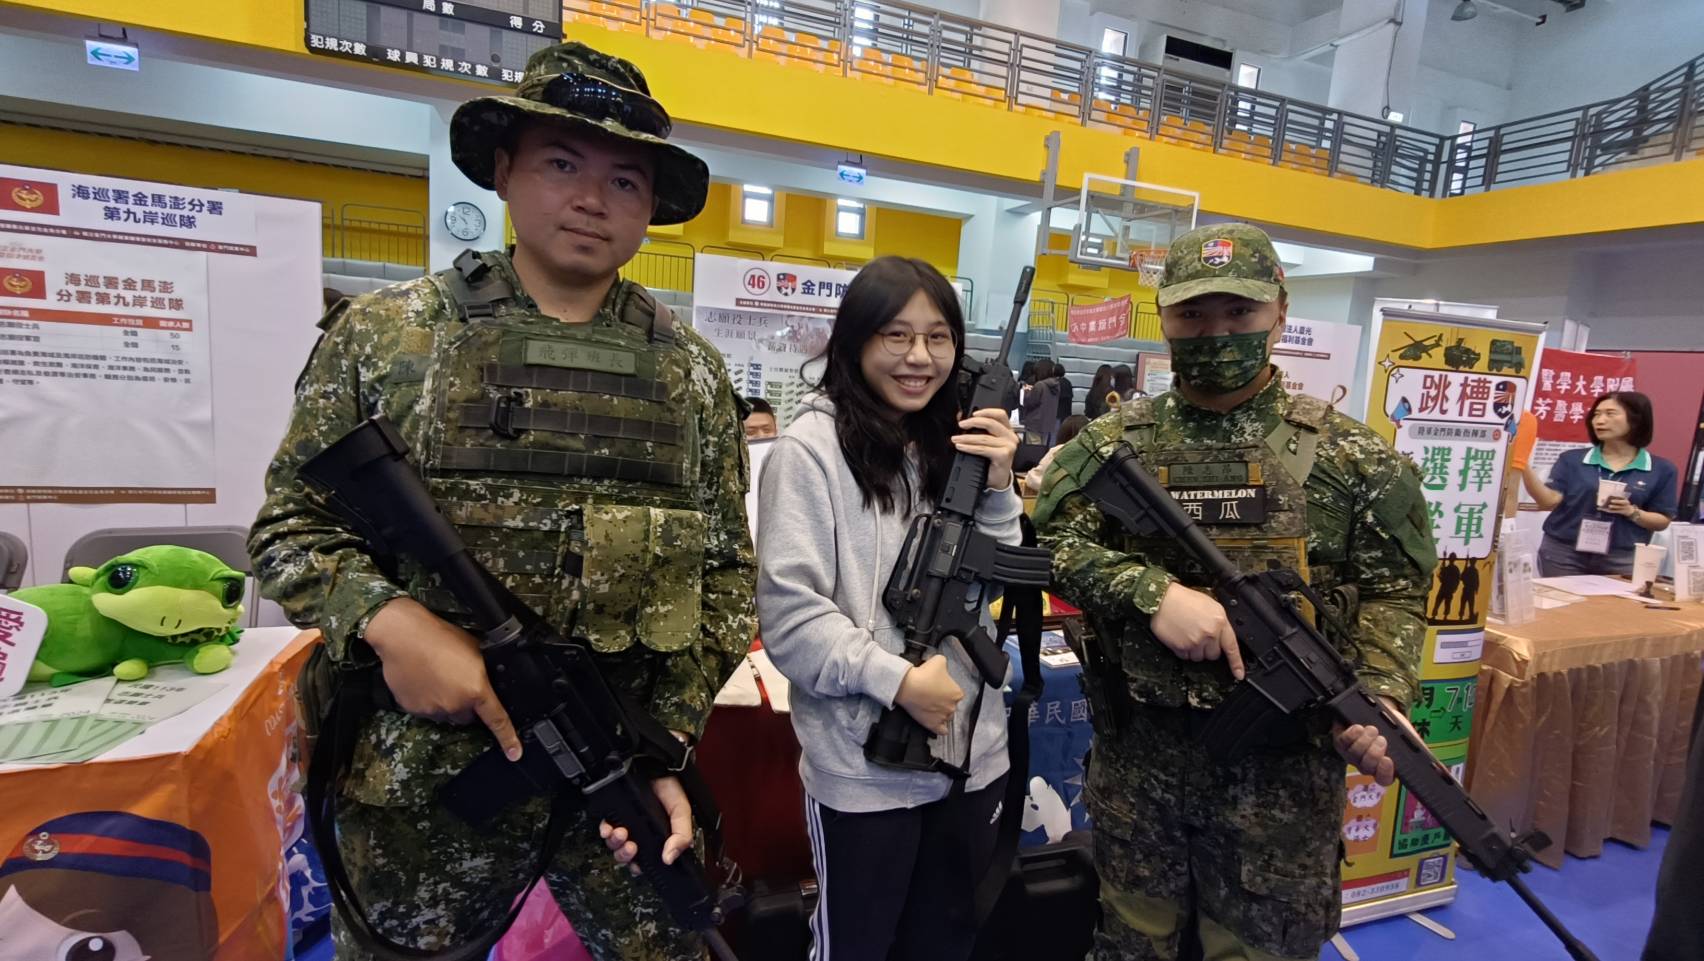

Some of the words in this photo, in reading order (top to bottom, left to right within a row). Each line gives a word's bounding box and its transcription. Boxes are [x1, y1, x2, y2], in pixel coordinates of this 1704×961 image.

[422, 0, 455, 17] 局數
[509, 15, 546, 33] 得分
[311, 34, 367, 57] 犯規次數
[387, 48, 489, 78] 球員犯規次數
[71, 184, 224, 216] 海巡署金馬澎分署
[103, 205, 197, 230] 第九岸巡隊
[64, 272, 175, 295] 海巡署金馬澎
[747, 275, 766, 289] 46
[56, 289, 185, 312] 分署第九岸巡隊
[1418, 373, 1493, 418] 跳槽
[1420, 445, 1497, 493] 選擇
[1170, 488, 1256, 500] WATERMELON
[1183, 500, 1241, 521] 西瓜
